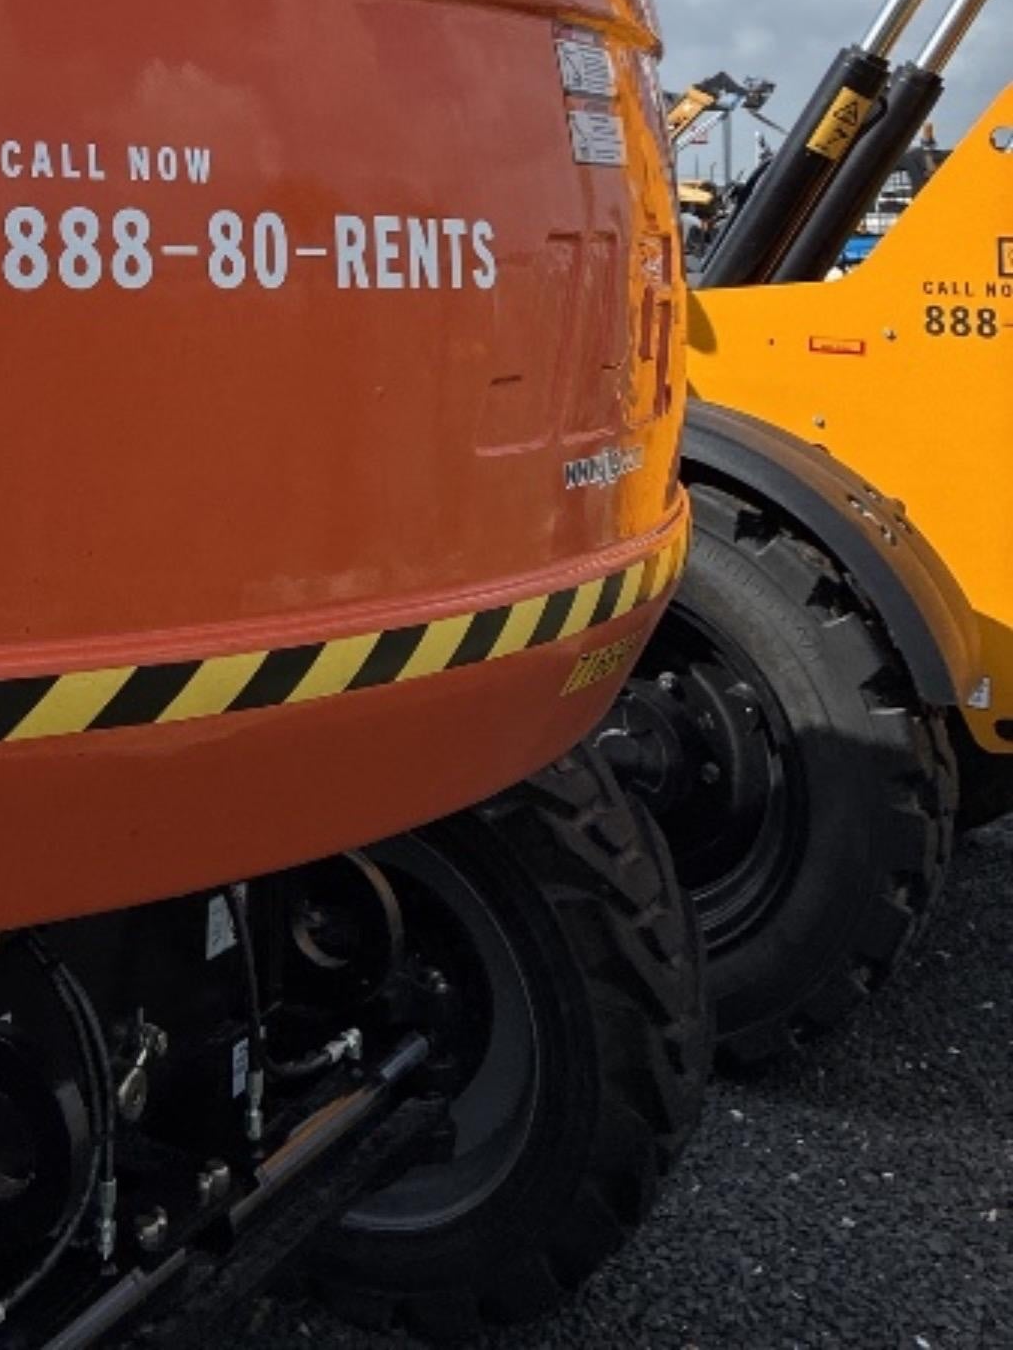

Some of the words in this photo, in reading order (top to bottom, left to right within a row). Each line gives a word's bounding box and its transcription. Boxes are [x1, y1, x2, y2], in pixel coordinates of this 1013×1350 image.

[0, 140, 105, 179] CALL
[127, 146, 211, 183] NOW
[2, 206, 498, 290] 888-80-RENTS
[922, 281, 975, 297] CALL
